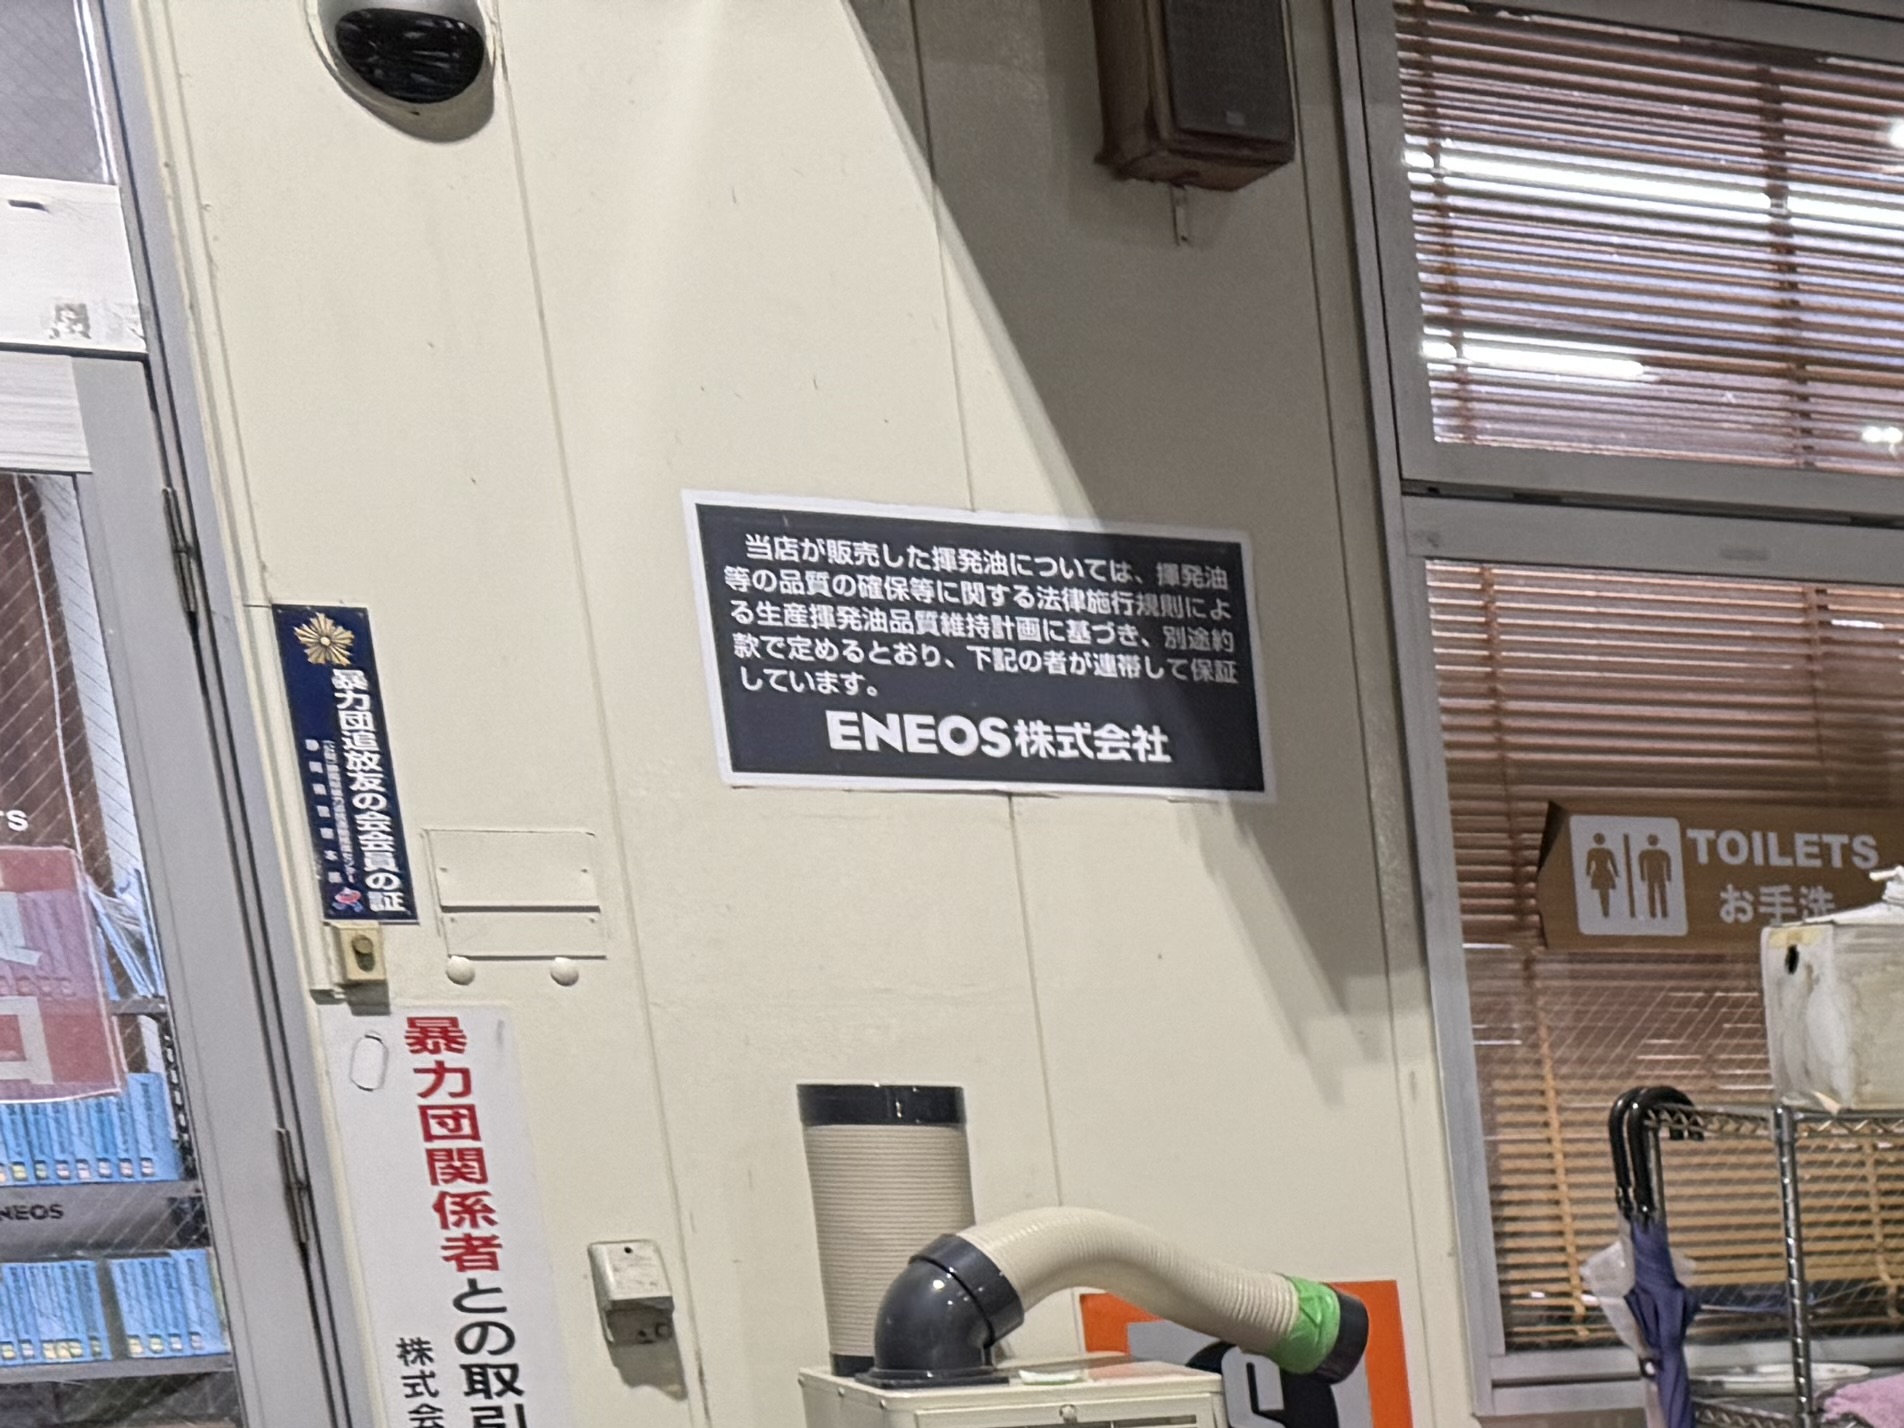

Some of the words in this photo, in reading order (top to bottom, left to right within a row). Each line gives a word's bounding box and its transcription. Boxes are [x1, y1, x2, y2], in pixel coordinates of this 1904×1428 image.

[745, 533, 1229, 591] 当店が販売した揮発油については、揮発油
[723, 565, 1232, 620] 等の品質の確保等に関する法律施行規則によ
[730, 600, 1235, 653] る生産揮発油品質維持計画に基づき、別途約
[732, 632, 1238, 684] 款で定めるとおり、下記の者が連帯して保証
[740, 666, 878, 697] しています。
[1687, 829, 1880, 870] TOILETS
